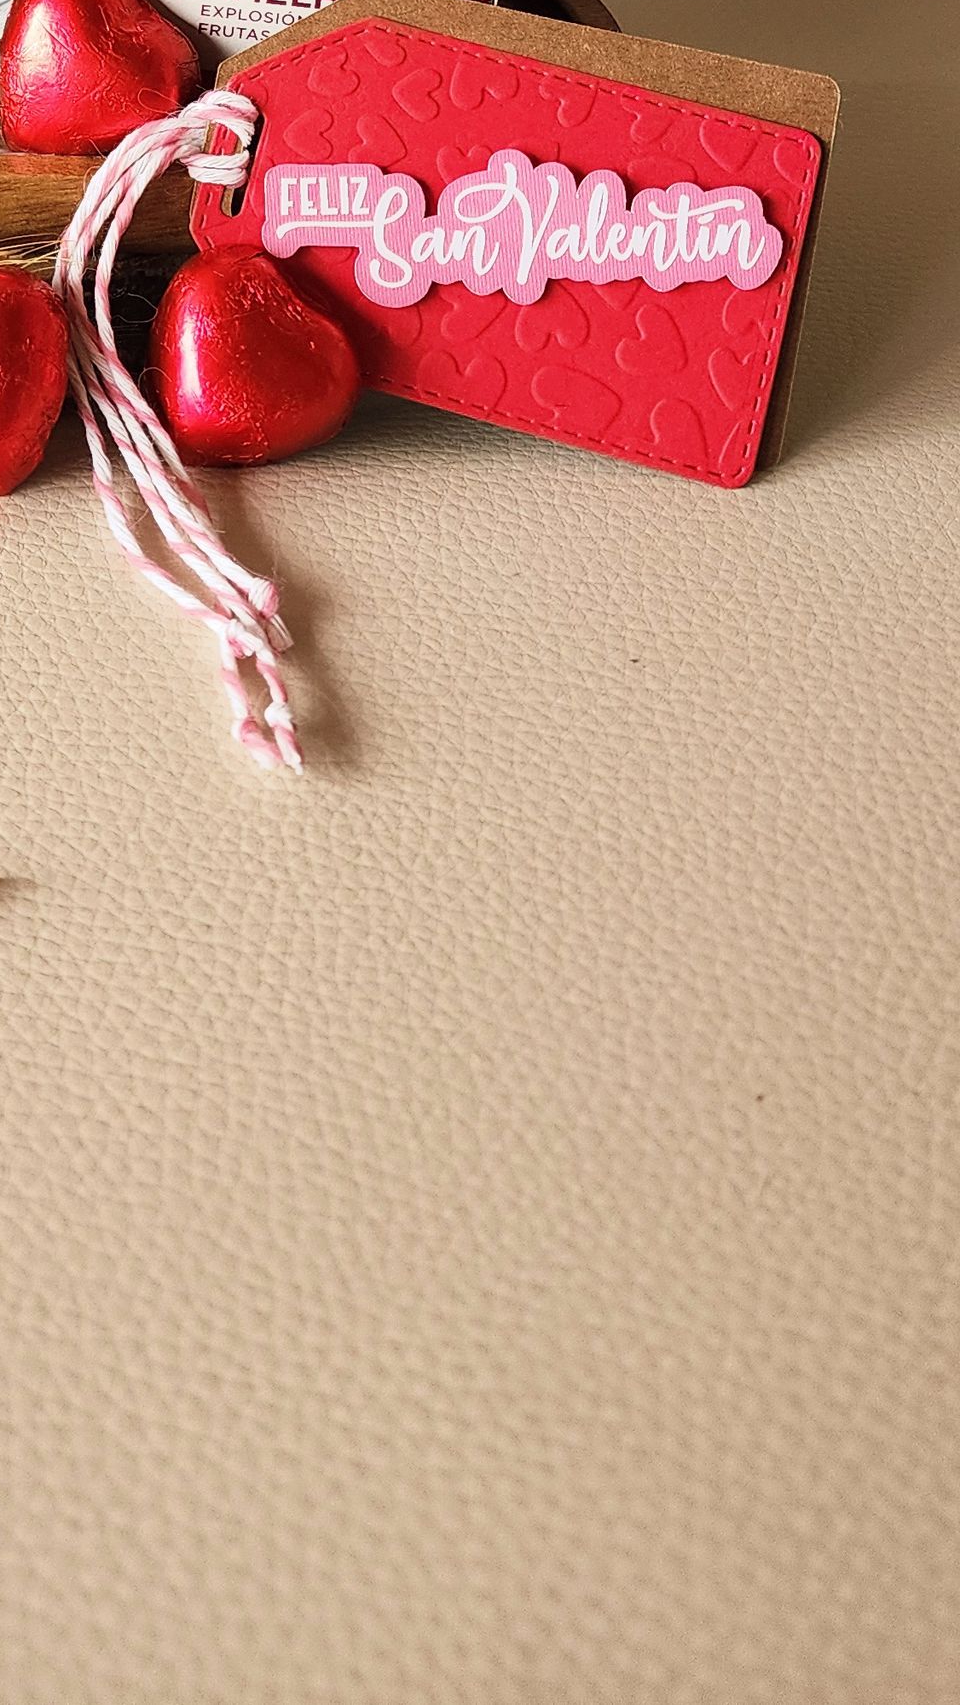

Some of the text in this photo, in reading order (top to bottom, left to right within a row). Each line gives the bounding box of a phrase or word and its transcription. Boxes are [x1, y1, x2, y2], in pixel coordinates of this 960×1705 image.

[200, 4, 303, 26] EXPLOSIÓ
[279, 162, 766, 289] FELIZ San Valentín
